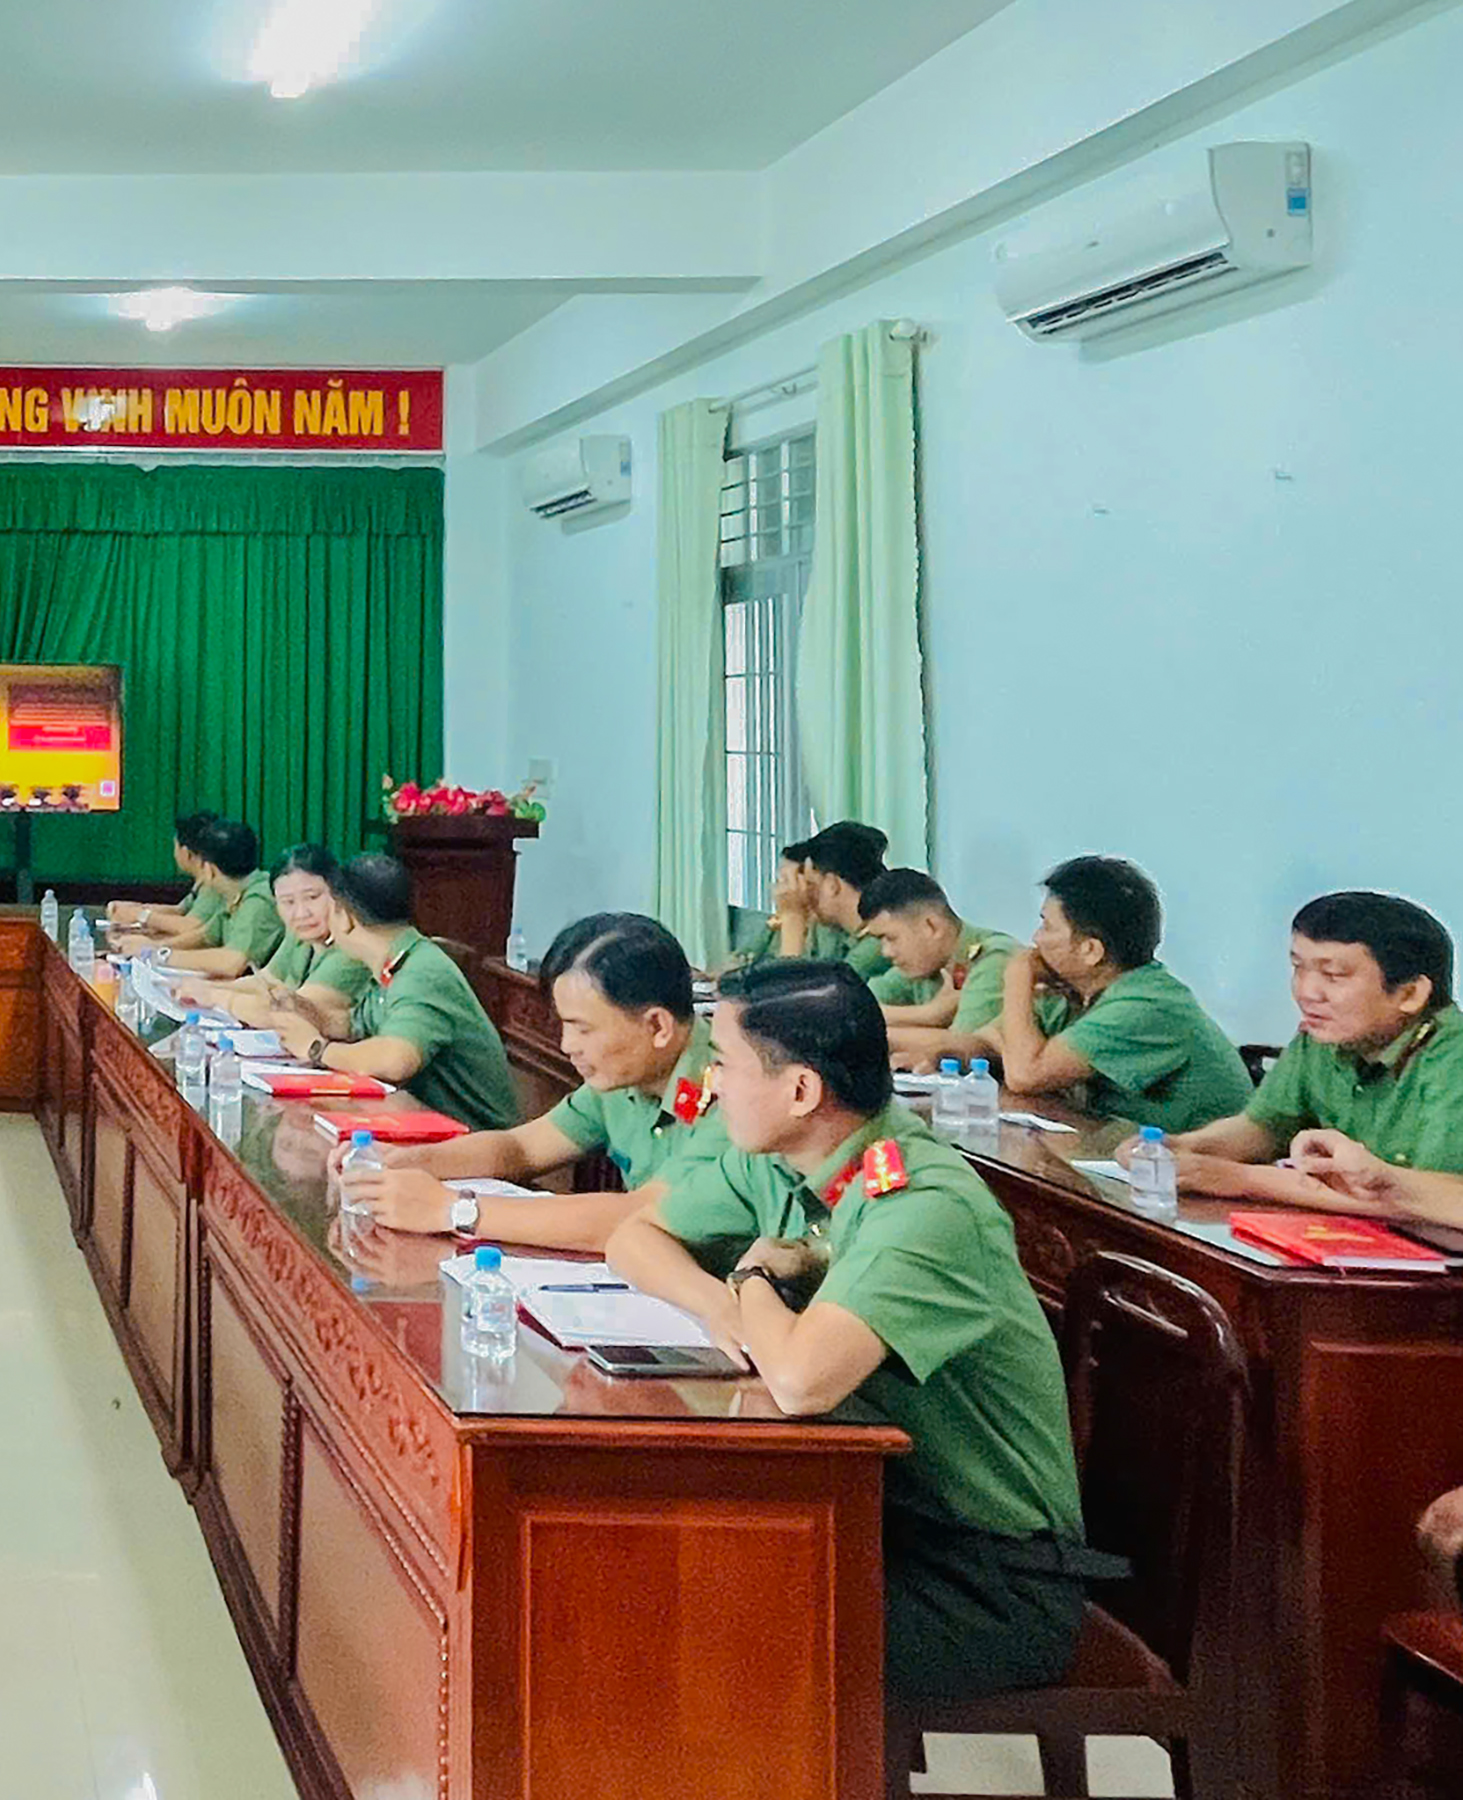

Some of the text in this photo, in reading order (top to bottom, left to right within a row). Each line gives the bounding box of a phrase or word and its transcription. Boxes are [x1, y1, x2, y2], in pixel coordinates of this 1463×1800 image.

[164, 378, 280, 434] MUÔN
[294, 380, 383, 435] NĂM
[399, 391, 409, 434] !
